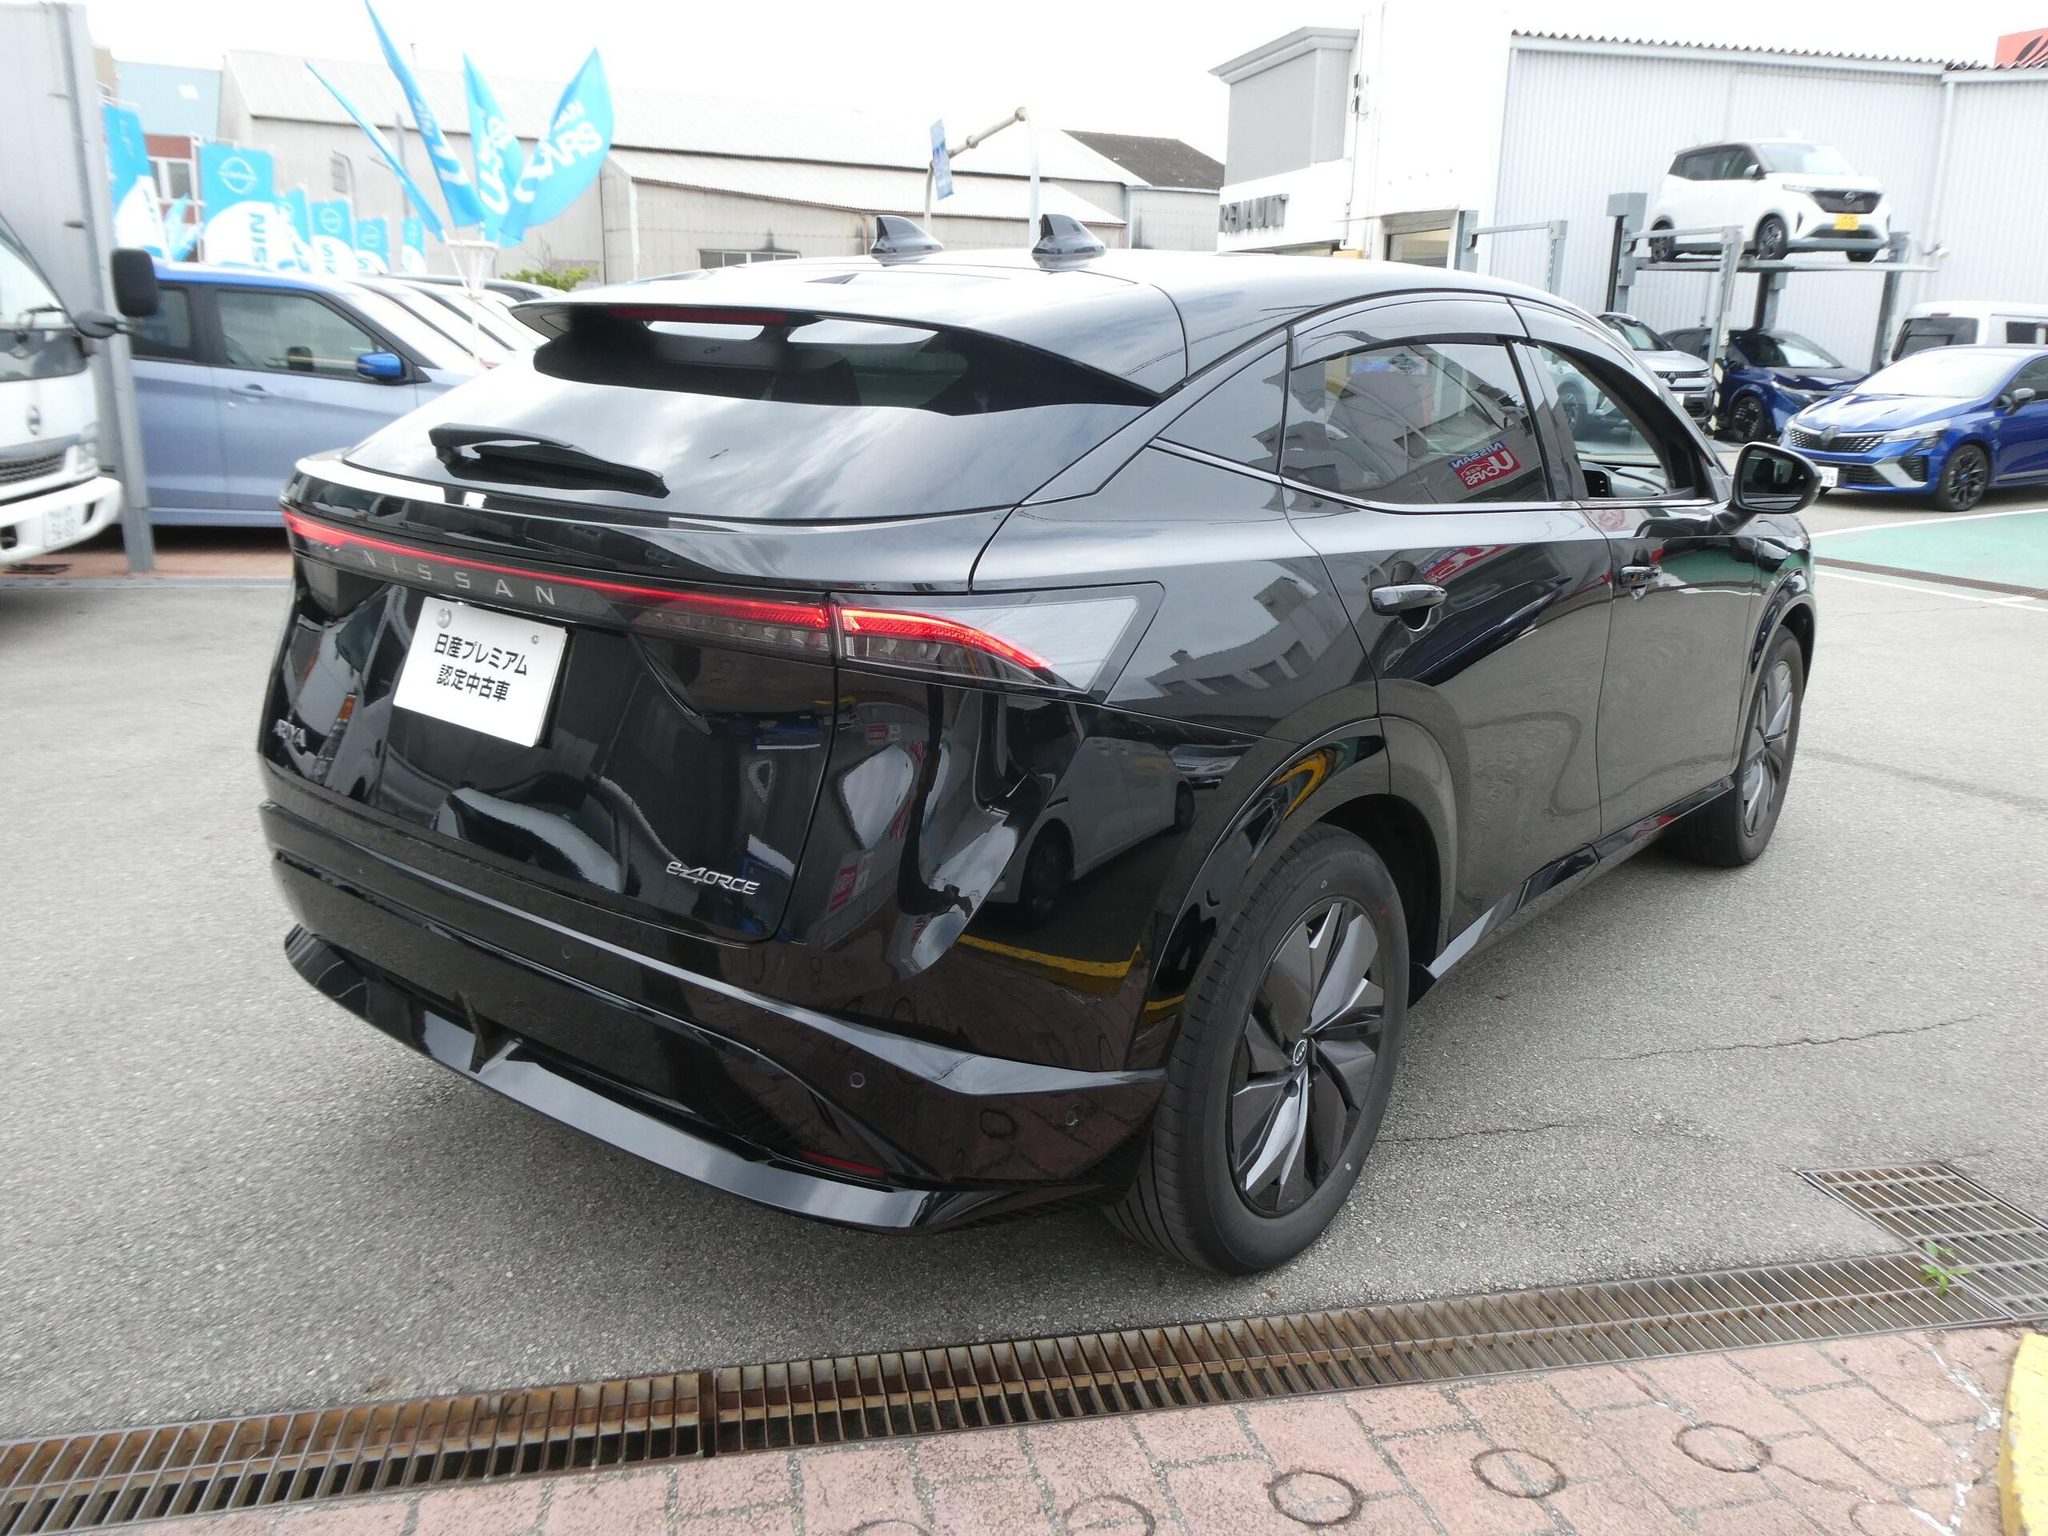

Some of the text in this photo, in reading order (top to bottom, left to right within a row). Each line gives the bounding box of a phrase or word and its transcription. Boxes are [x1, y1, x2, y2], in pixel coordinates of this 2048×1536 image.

[363, 550, 556, 606] NISSAN
[434, 633, 528, 676] 日産プレミアム
[436, 664, 511, 702] 認定中古車
